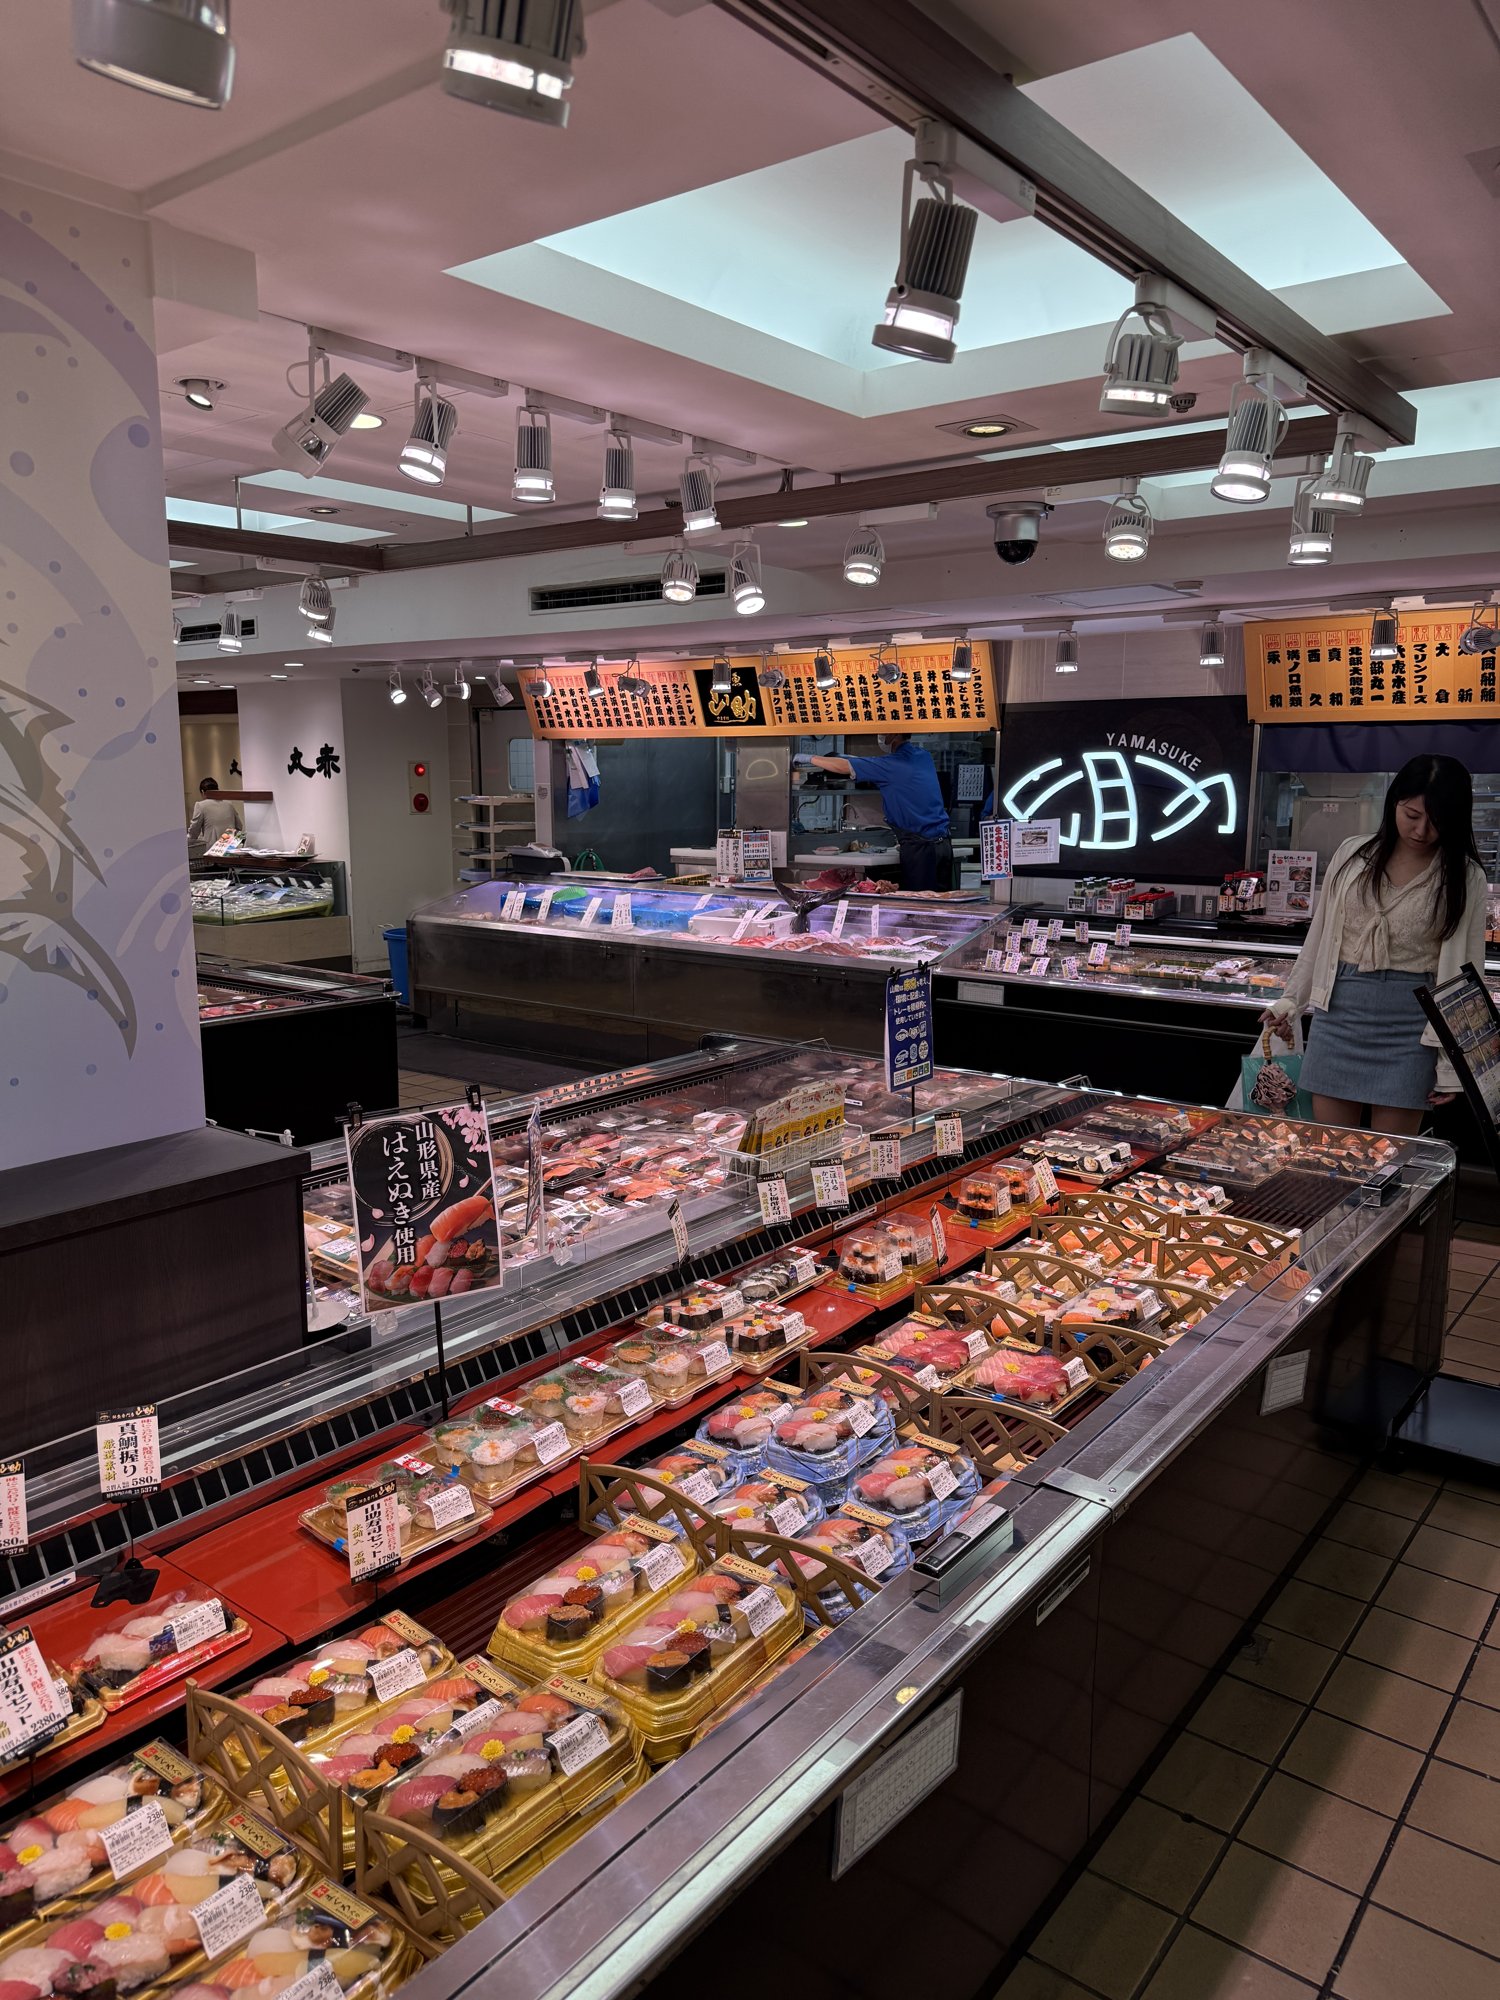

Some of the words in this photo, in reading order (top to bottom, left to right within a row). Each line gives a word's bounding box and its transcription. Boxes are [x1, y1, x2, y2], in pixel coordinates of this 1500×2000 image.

[1413, 643, 1427, 704] マリンフーズ
[620, 693, 633, 727] 須賀魚市場
[773, 689, 782, 723] ョクヨー
[913, 671, 928, 719] 長井水産
[942, 670, 957, 719] 石川水産
[601, 696, 613, 727] 浜丸魚
[1106, 733, 1202, 772] YAMASUKE
[415, 1121, 442, 1201] 山形県産
[822, 1171, 831, 1199] かにタワー
[829, 1167, 838, 1191] こぼれる
[383, 1132, 416, 1265] はえぬき使用
[135, 1405, 155, 1417] 山助
[103, 1439, 117, 1481] 厳選素材
[118, 1422, 139, 1478] 真鯛握り
[132, 1476, 158, 1486] 580円
[379, 1482, 395, 1496] 山助
[365, 1502, 384, 1558] 山助寿司セット
[212, 1605, 224, 1617] 580
[7, 1629, 29, 1648] 山助
[30, 1712, 62, 1734] 2380円
[147, 1808, 165, 1825] 2380
[239, 1881, 258, 1898] 2380
[318, 1971, 337, 1990] 2380
